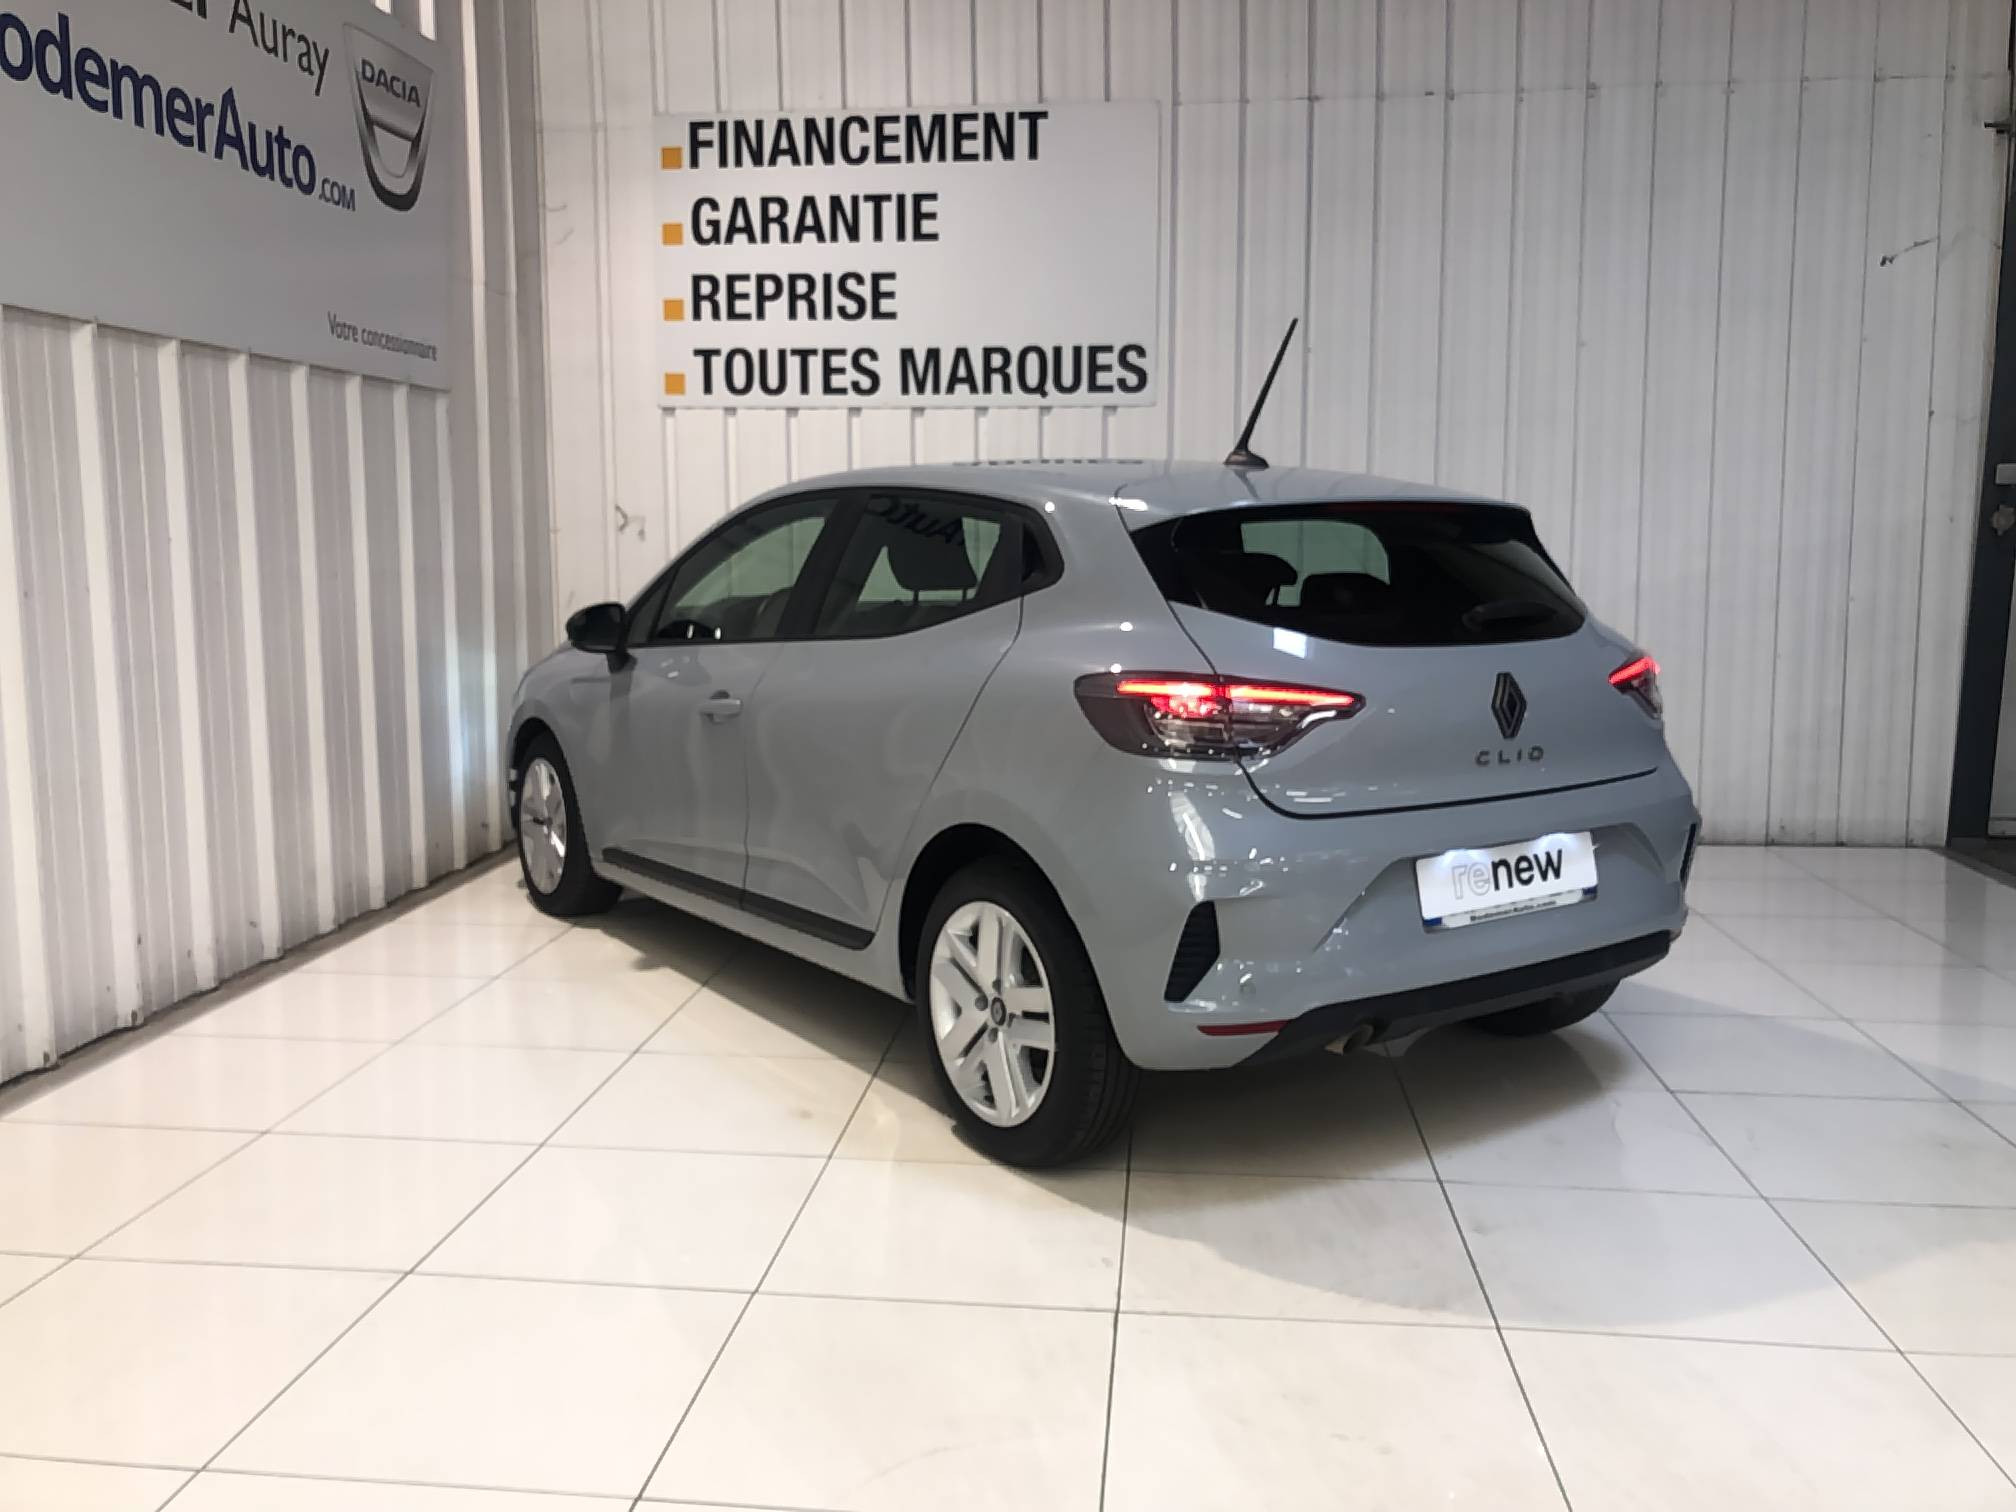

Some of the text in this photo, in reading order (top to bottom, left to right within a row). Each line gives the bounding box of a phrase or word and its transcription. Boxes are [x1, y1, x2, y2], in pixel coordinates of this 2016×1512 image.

[229, 0, 330, 96] Auray
[360, 58, 421, 107] DACIA
[688, 111, 1049, 169] FINANCEMENT
[691, 193, 939, 245] GARANTIE
[691, 272, 898, 321] REPRISE
[327, 311, 359, 343] Votre
[694, 344, 1148, 398] TOUTES MARQUES
[1474, 745, 1544, 766] CLIO
[1452, 848, 1563, 900] renew
